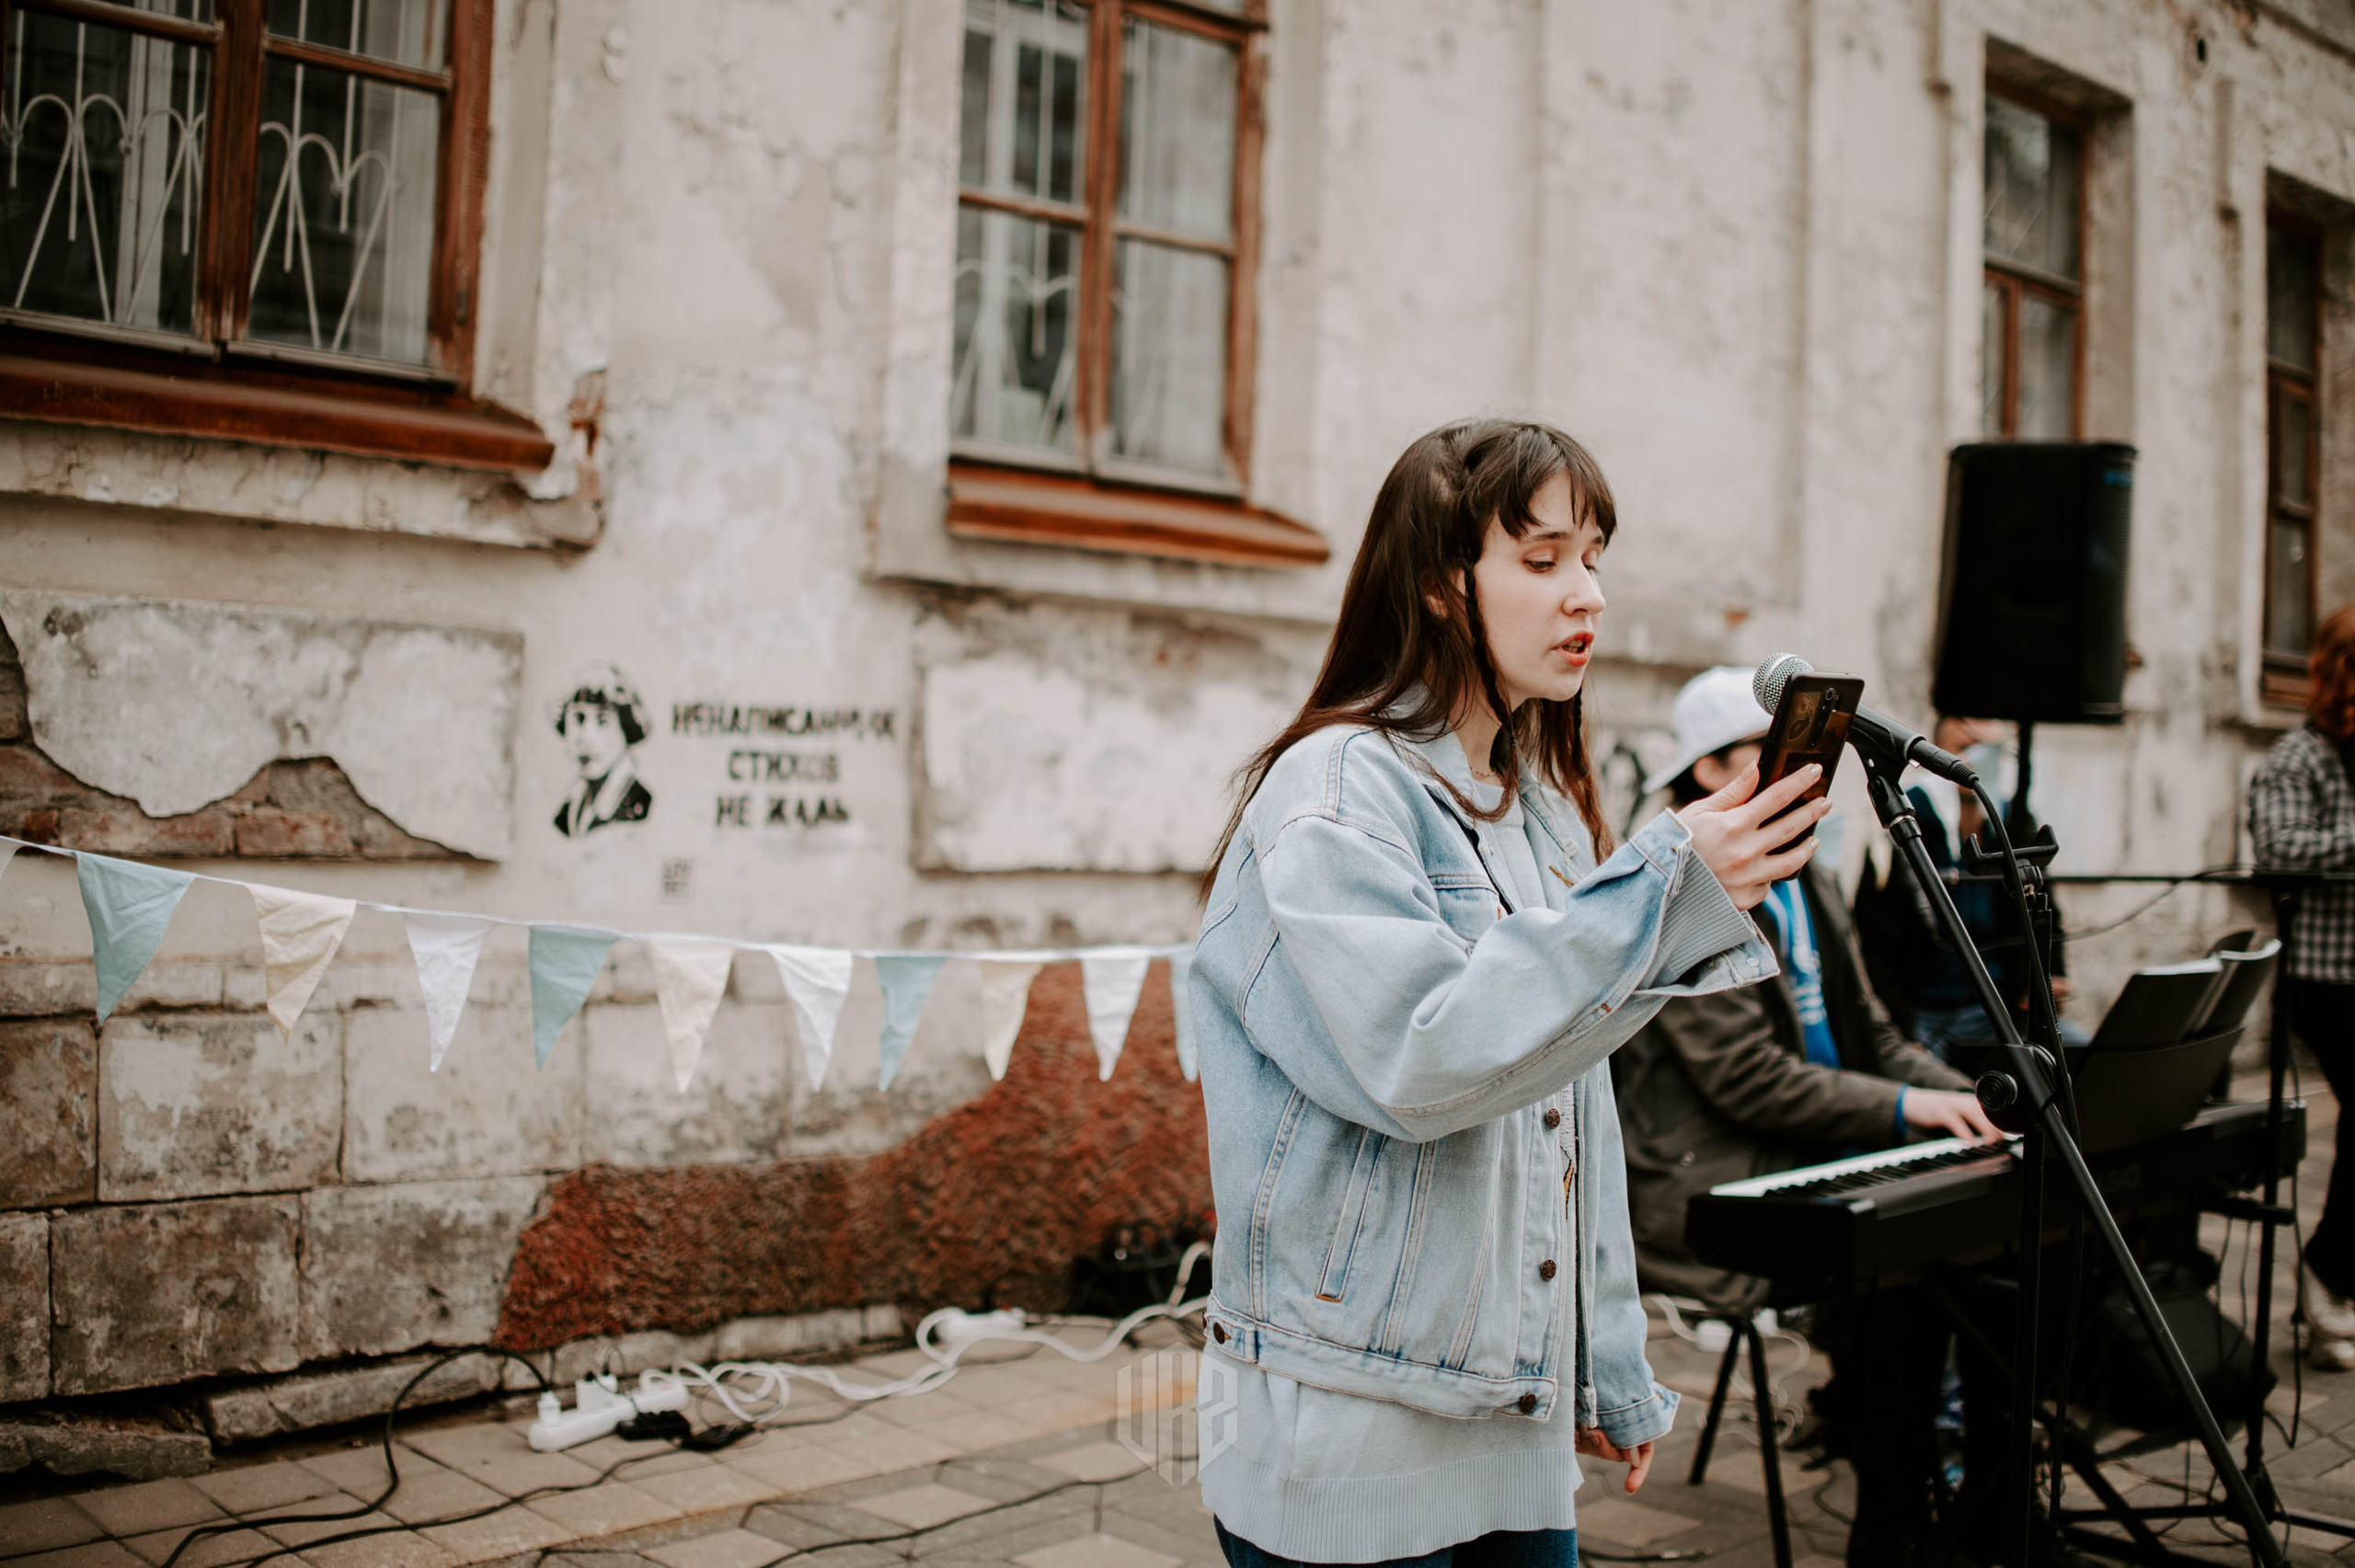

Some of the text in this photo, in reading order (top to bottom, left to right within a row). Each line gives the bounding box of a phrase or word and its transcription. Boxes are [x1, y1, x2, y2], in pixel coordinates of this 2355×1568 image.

[728, 750, 838, 781] СТИХОВ
[716, 795, 849, 828] НЕ ЖАЛЬ
